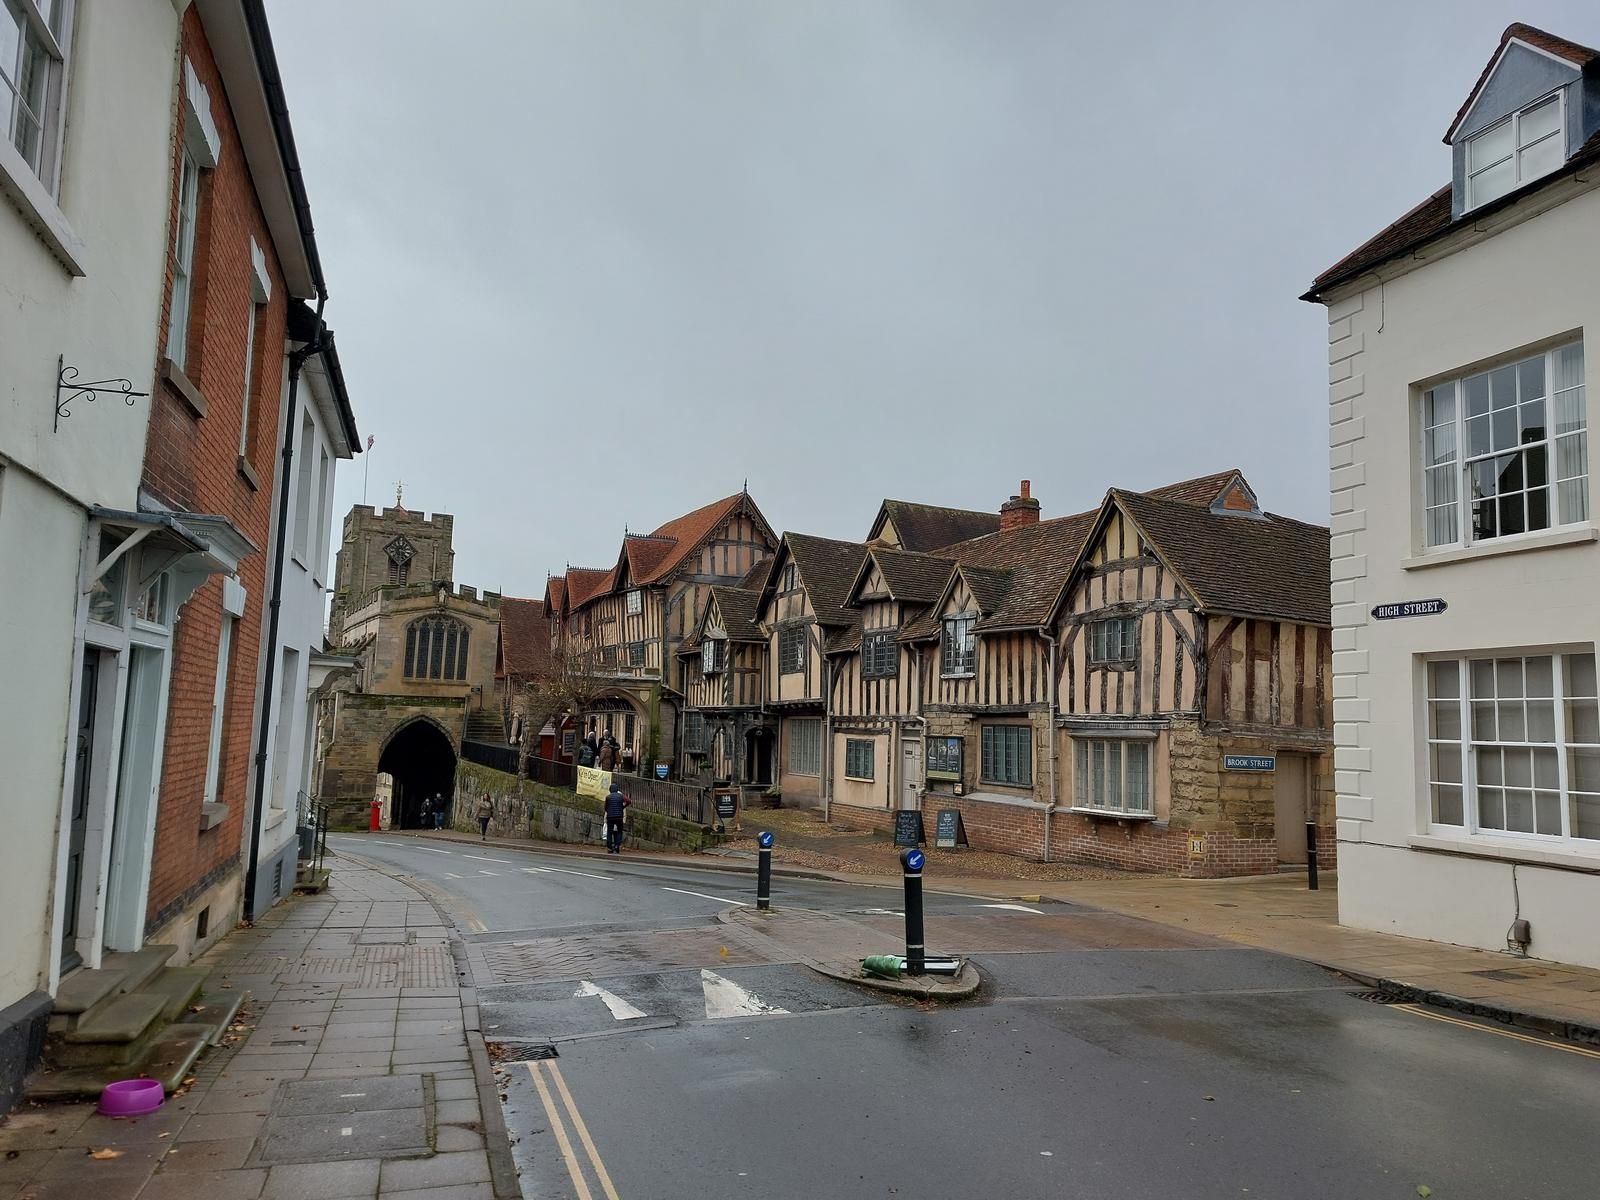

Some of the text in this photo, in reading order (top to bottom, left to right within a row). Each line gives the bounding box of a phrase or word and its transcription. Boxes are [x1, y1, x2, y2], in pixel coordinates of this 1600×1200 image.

[1378, 601, 1439, 617] HIGH STREET
[1227, 758, 1273, 768] BROOK STREET
